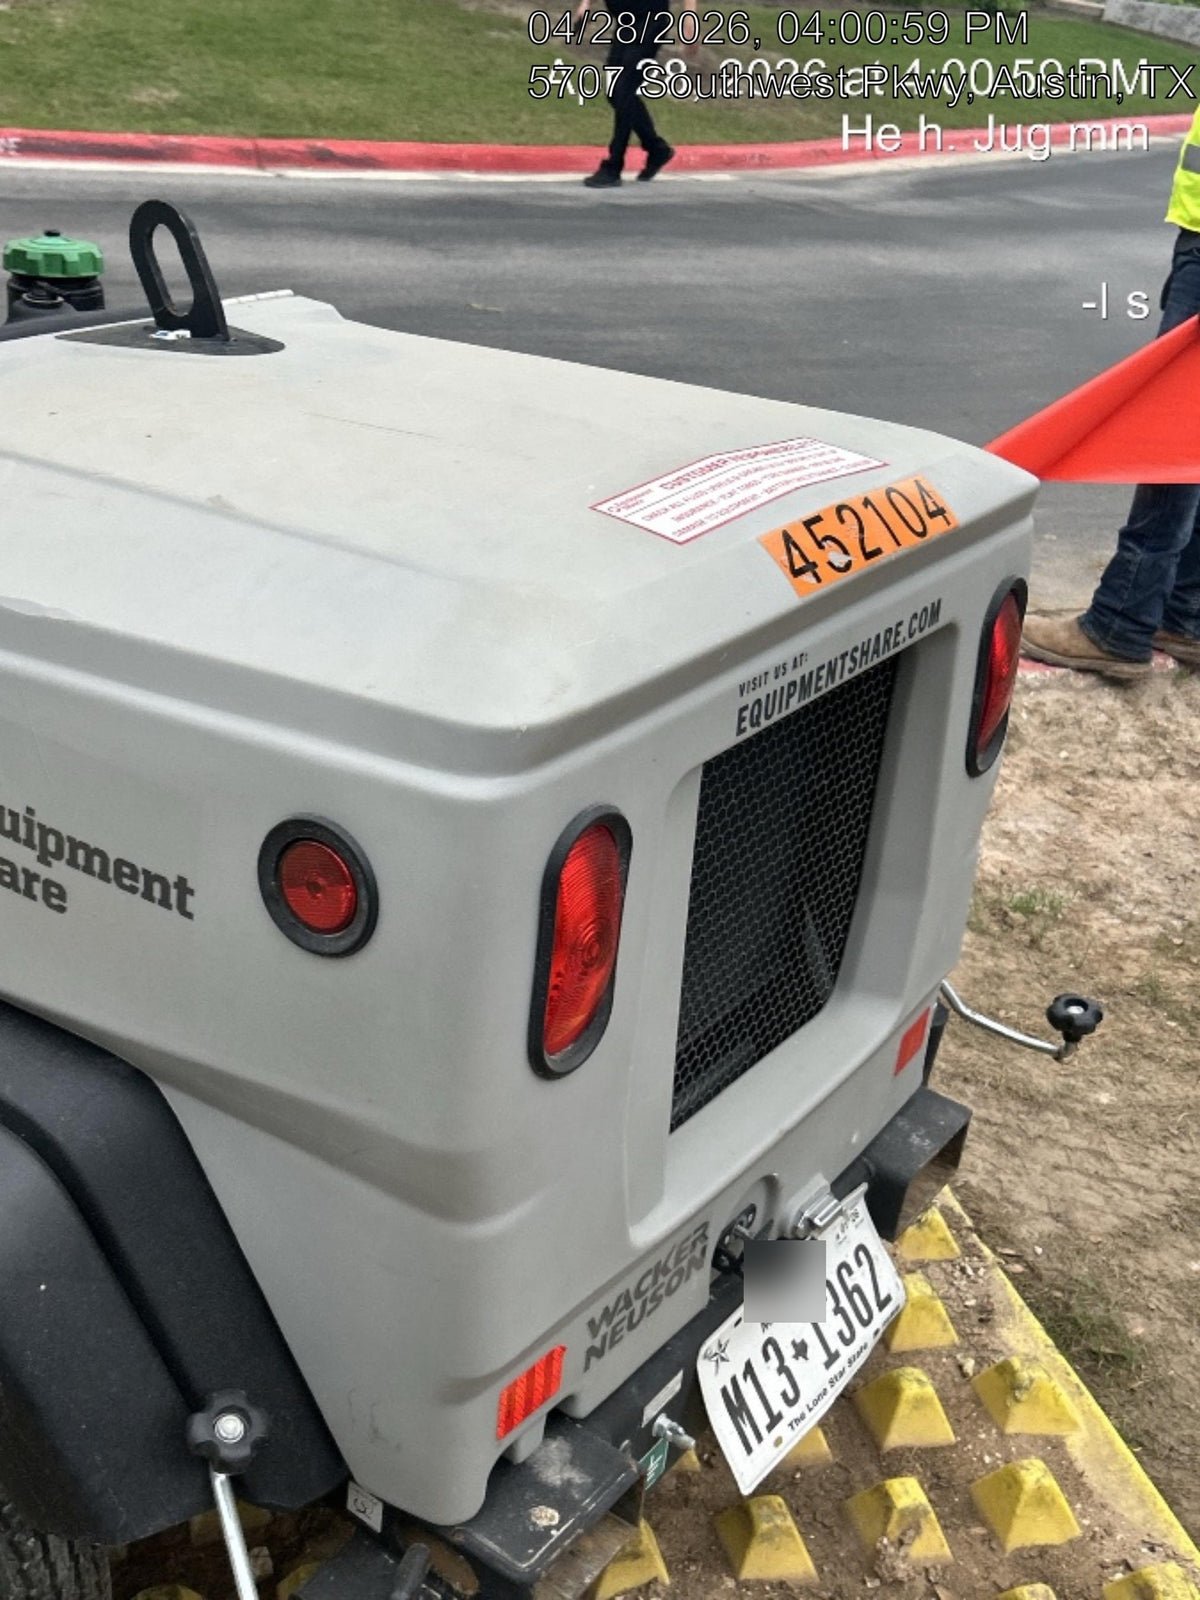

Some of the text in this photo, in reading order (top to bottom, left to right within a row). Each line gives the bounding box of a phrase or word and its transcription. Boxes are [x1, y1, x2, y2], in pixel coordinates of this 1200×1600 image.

[781, 479, 952, 584] 452104
[736, 598, 942, 737] EQUIPMENTSHARE.COM
[739, 652, 809, 697] VISIT US AT:
[583, 1243, 708, 1374] NEUSON
[586, 1221, 710, 1340] WACKER
[788, 1341, 868, 1431] The Lone Star State
